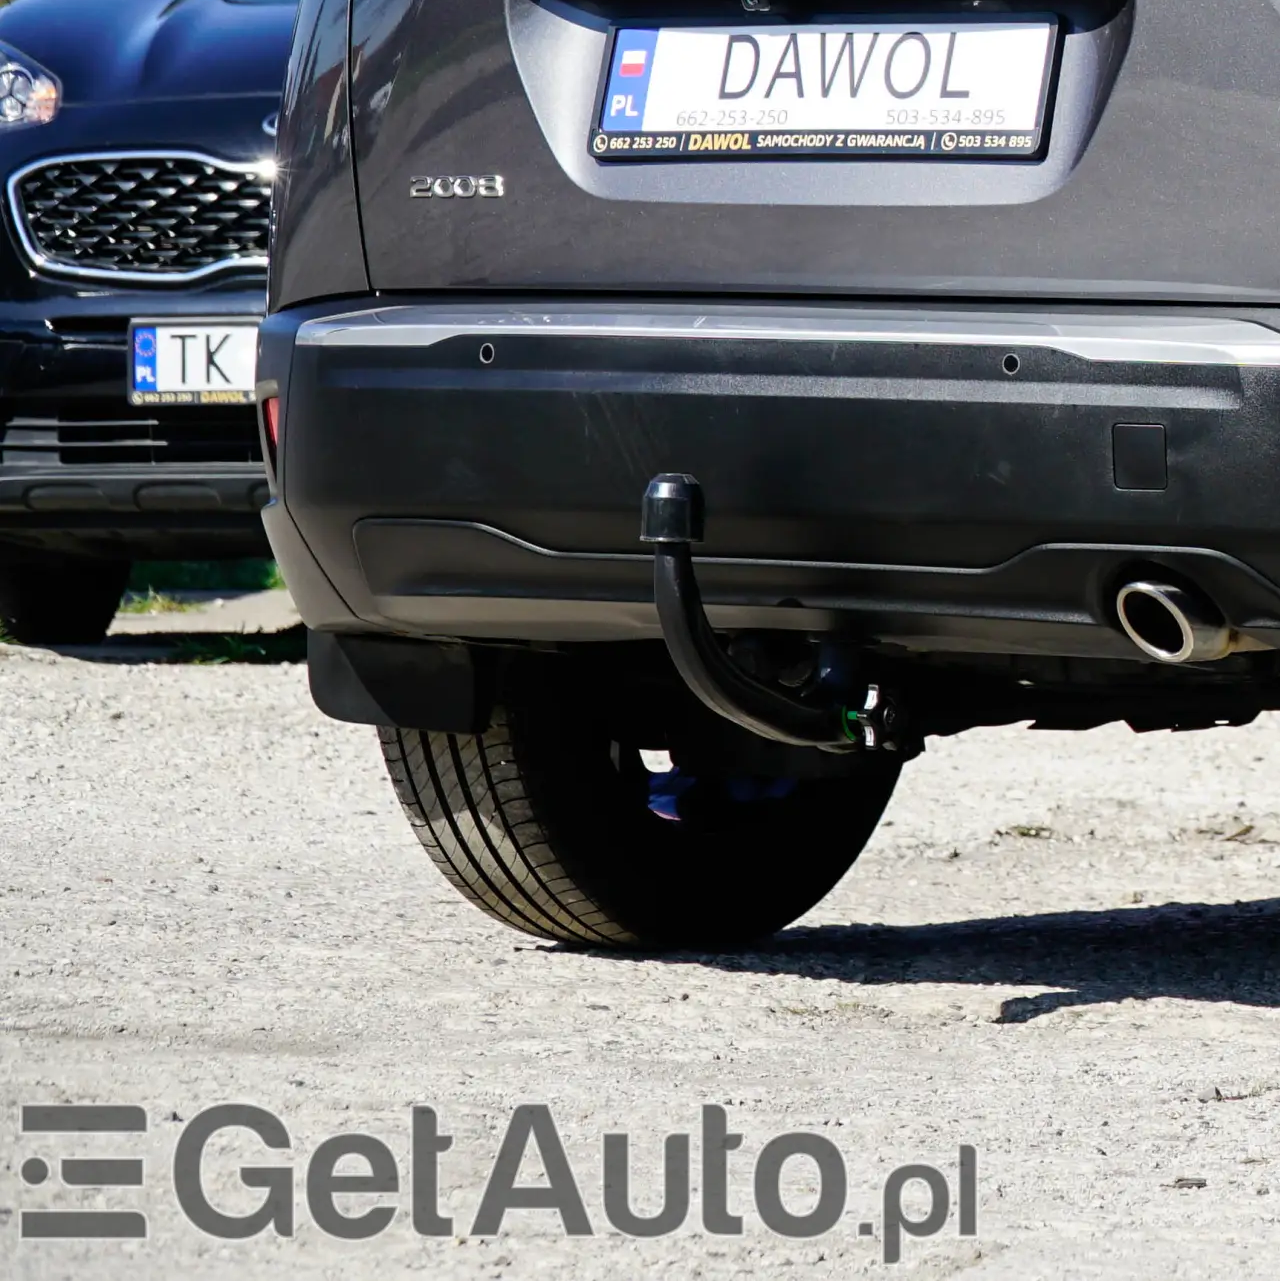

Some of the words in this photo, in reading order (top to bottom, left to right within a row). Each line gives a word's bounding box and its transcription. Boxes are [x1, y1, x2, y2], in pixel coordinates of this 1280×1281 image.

[718, 31, 971, 101] DAWOL
[610, 94, 639, 117] PL
[676, 109, 788, 127] 662-253-250
[885, 108, 1006, 125] 503-534-895
[609, 137, 630, 149] 662
[632, 137, 653, 149] 253
[655, 136, 677, 149] 250
[688, 133, 752, 151] DAWOL
[756, 134, 835, 148] SAMOCHODY
[835, 135, 845, 147] Z
[847, 134, 925, 150] GWARANCJĄ
[958, 135, 981, 148] 503
[984, 135, 1006, 148] 534
[1008, 135, 1032, 148] 895
[410, 175, 504, 198] 2008
[170, 333, 232, 385] TK
[136, 365, 156, 383] PL
